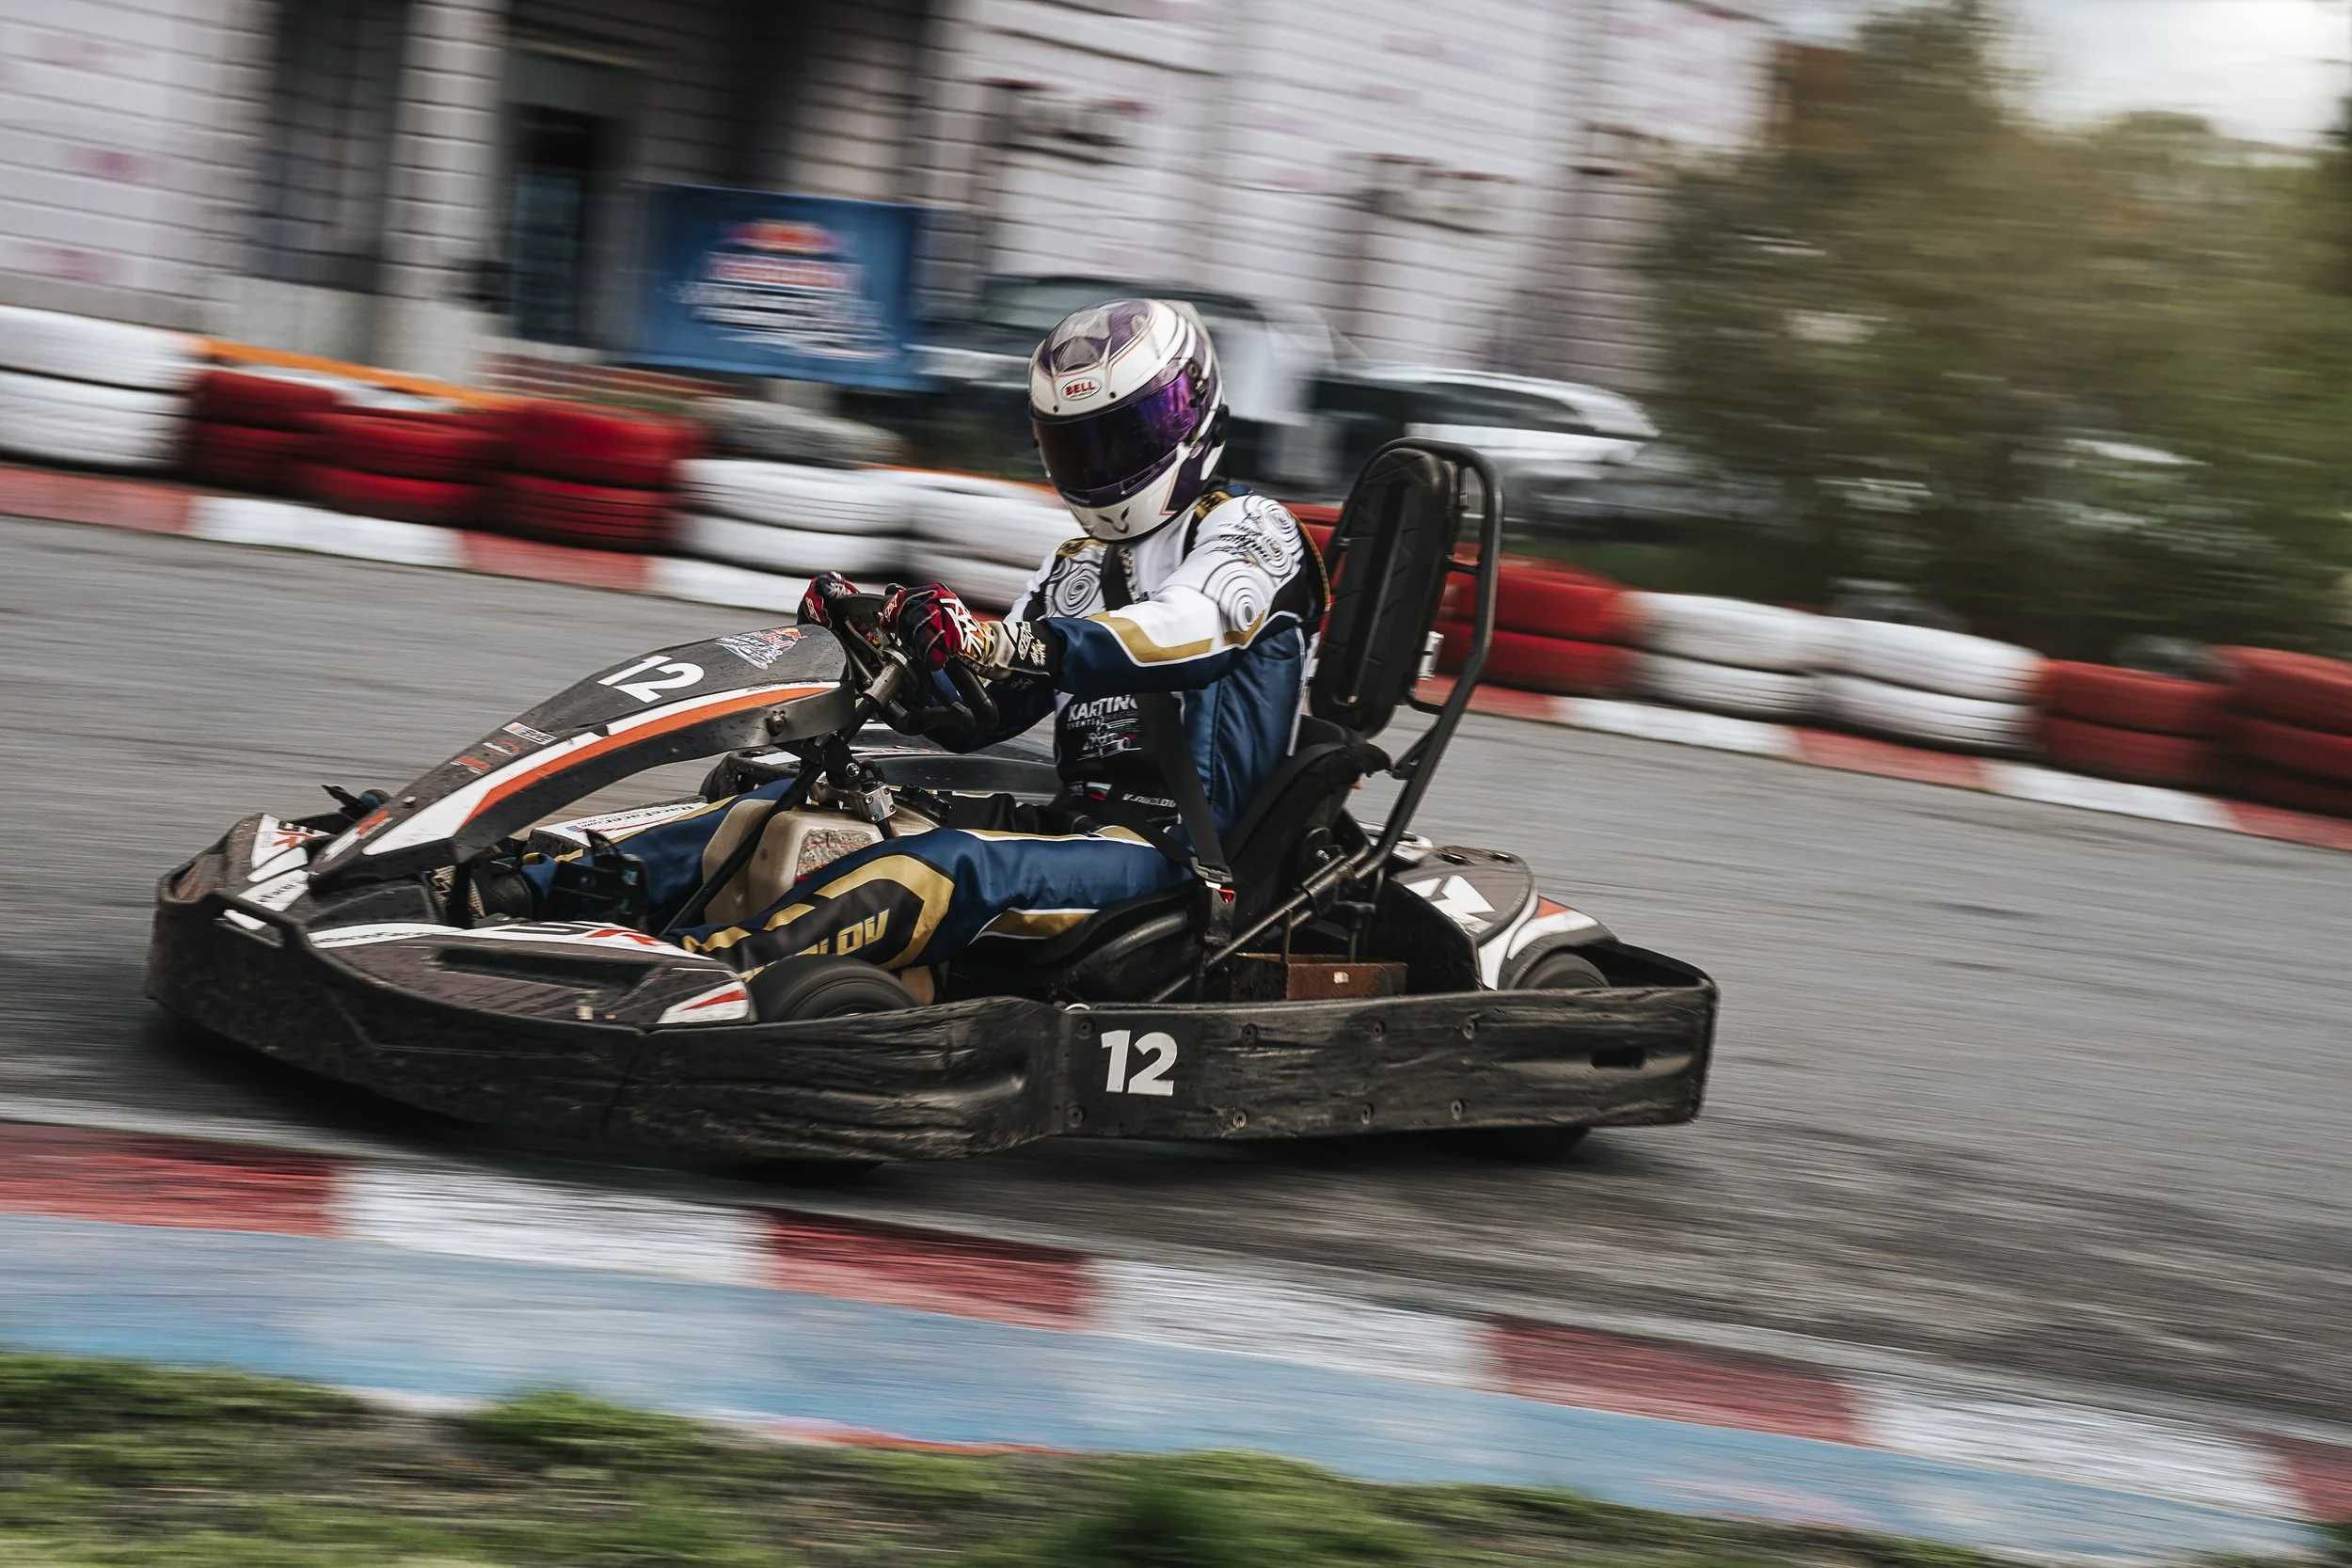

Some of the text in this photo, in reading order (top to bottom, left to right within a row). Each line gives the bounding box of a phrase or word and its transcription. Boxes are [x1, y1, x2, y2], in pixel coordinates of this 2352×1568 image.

[1065, 381, 1095, 395] BELL
[596, 655, 705, 704] 12
[1101, 1030, 1178, 1097] 12
